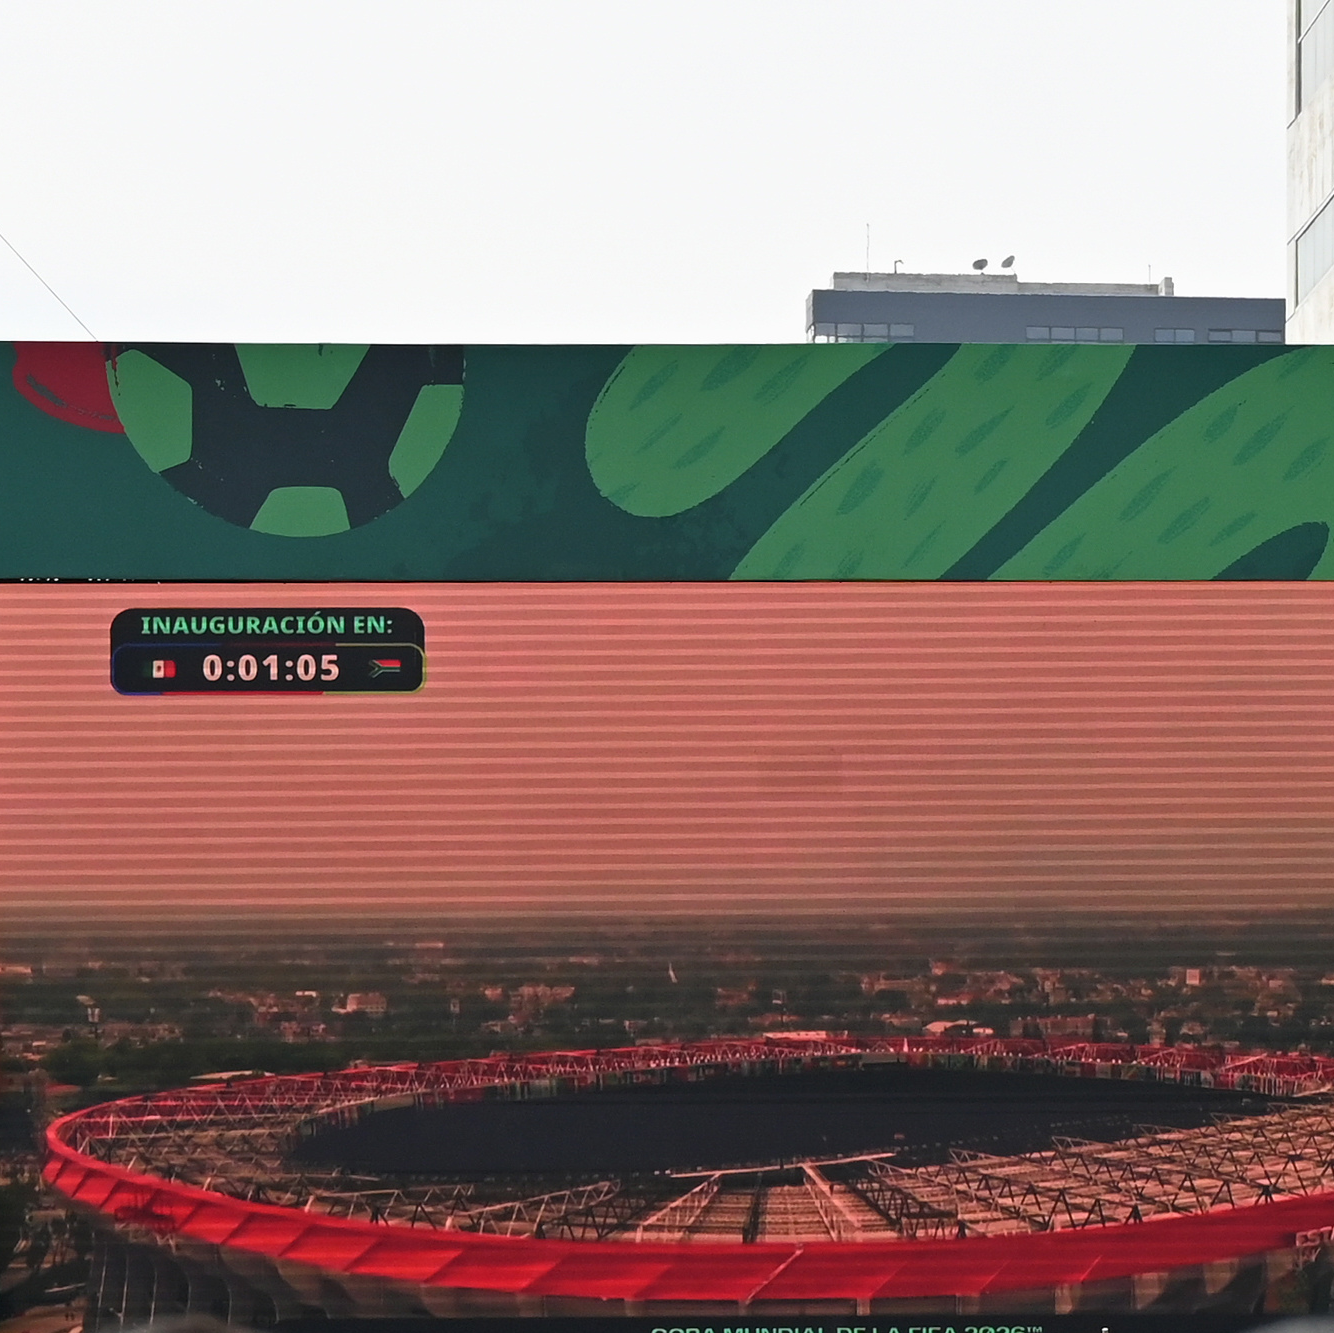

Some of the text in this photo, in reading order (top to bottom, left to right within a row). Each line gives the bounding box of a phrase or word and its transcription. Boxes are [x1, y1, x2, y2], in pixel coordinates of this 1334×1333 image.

[141, 611, 394, 634] INAUGURACIÓN EN:
[202, 654, 340, 682] 0:01:05
